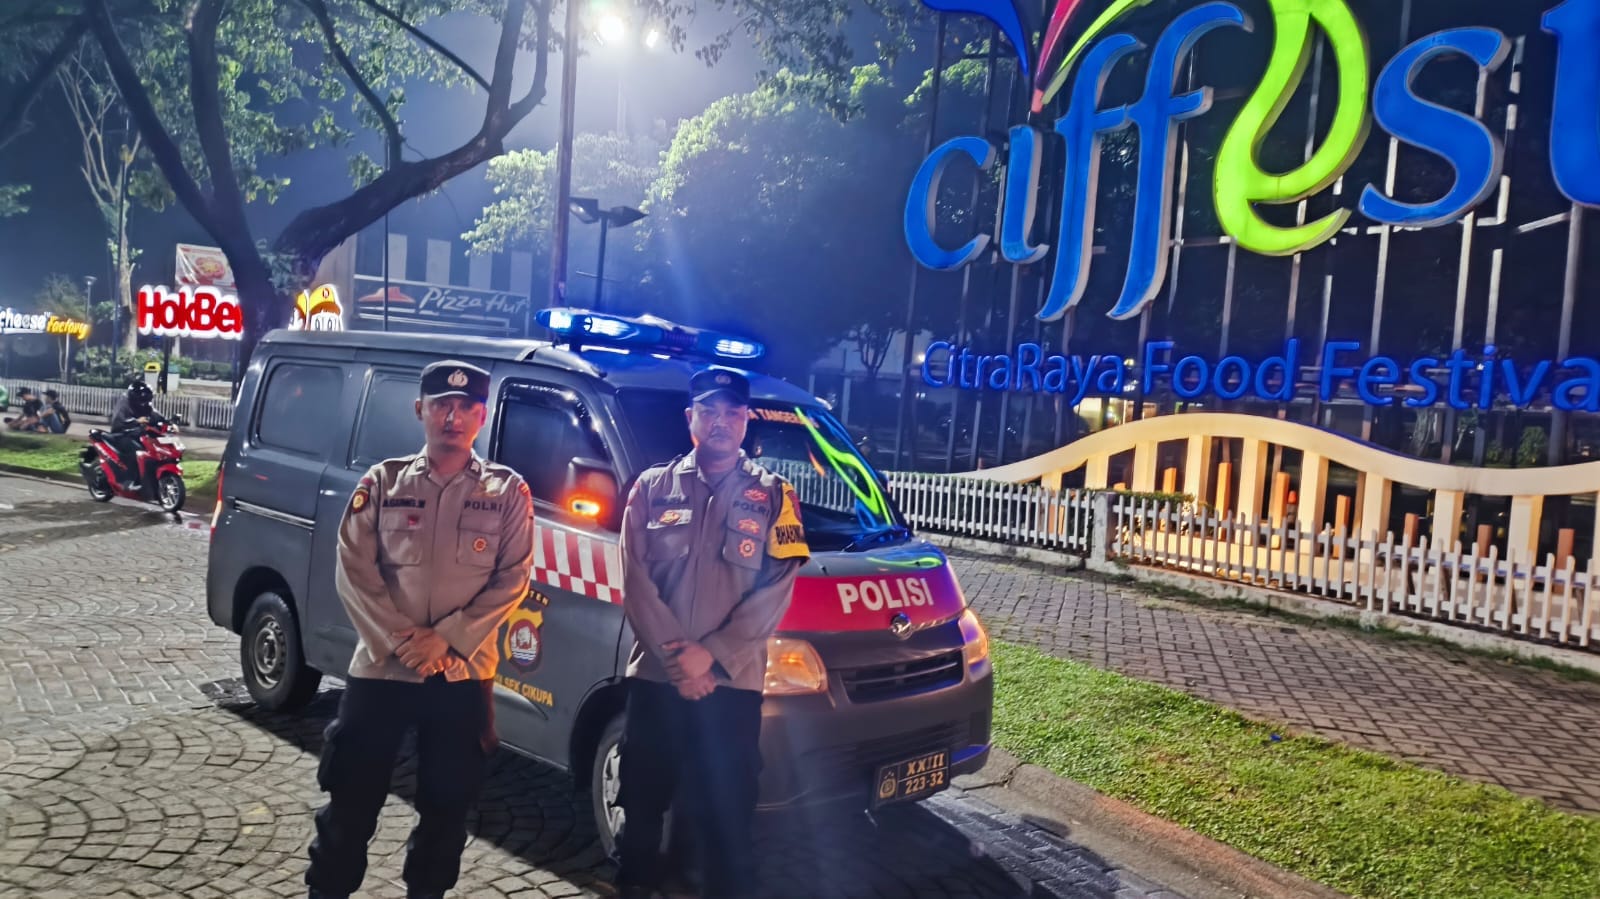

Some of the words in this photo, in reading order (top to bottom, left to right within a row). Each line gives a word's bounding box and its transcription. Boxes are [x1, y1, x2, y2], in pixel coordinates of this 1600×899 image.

[419, 287, 481, 311] Pizza
[484, 292, 527, 314] Hut
[921, 340, 1124, 407] CitraRaya
[1143, 338, 1297, 400] Food
[463, 500, 503, 513] POLRI
[732, 501, 771, 518] POLRI
[836, 577, 934, 614] POLISI
[521, 683, 554, 707] CIKUPA
[907, 753, 945, 776] XXIII
